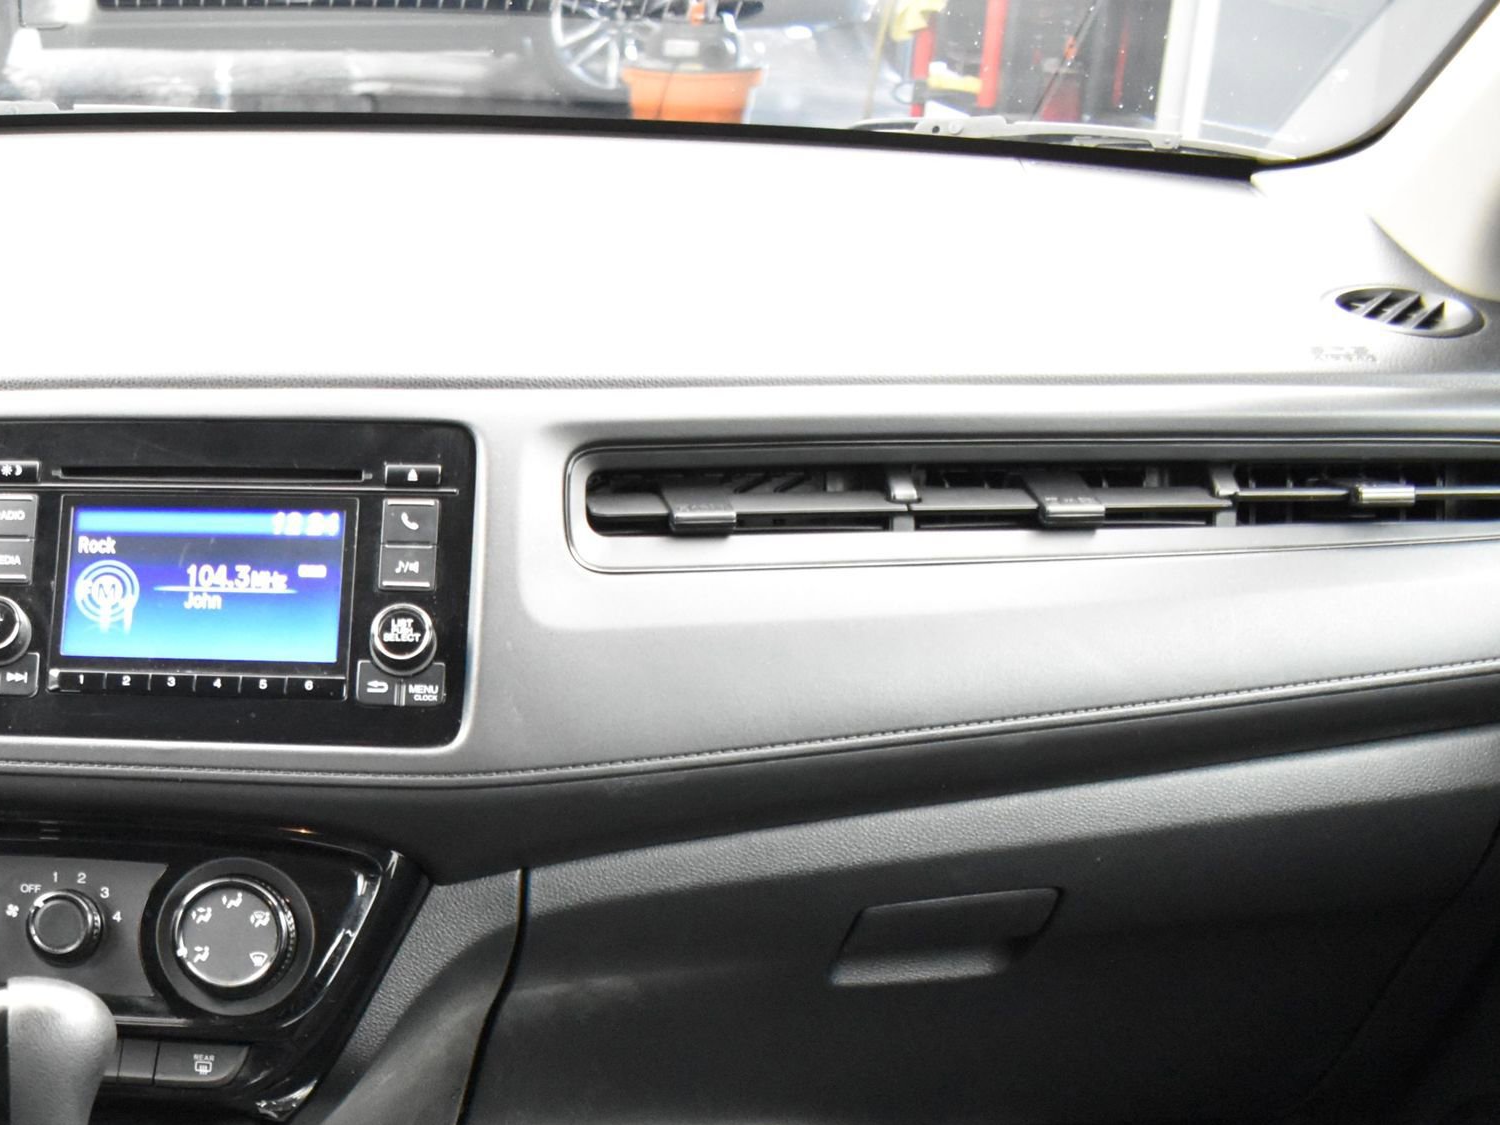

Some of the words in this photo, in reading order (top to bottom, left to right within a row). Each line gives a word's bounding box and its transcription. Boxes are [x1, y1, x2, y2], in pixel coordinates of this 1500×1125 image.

[77, 535, 117, 555] Rock
[183, 591, 223, 610] John
[383, 632, 422, 643] SELECT
[78, 674, 85, 685] 1
[121, 675, 132, 687] 2
[166, 675, 177, 687] 3
[212, 677, 223, 689] 4
[258, 678, 269, 690] 5
[304, 679, 314, 691] 6
[408, 684, 439, 695] MENU
[413, 694, 438, 702] CLOCK
[52, 871, 59, 883] 1
[76, 872, 87, 884] 2
[19, 883, 42, 894] OFF
[100, 887, 110, 898] 3
[111, 911, 123, 923] 4
[193, 1053, 215, 1062] REAR
